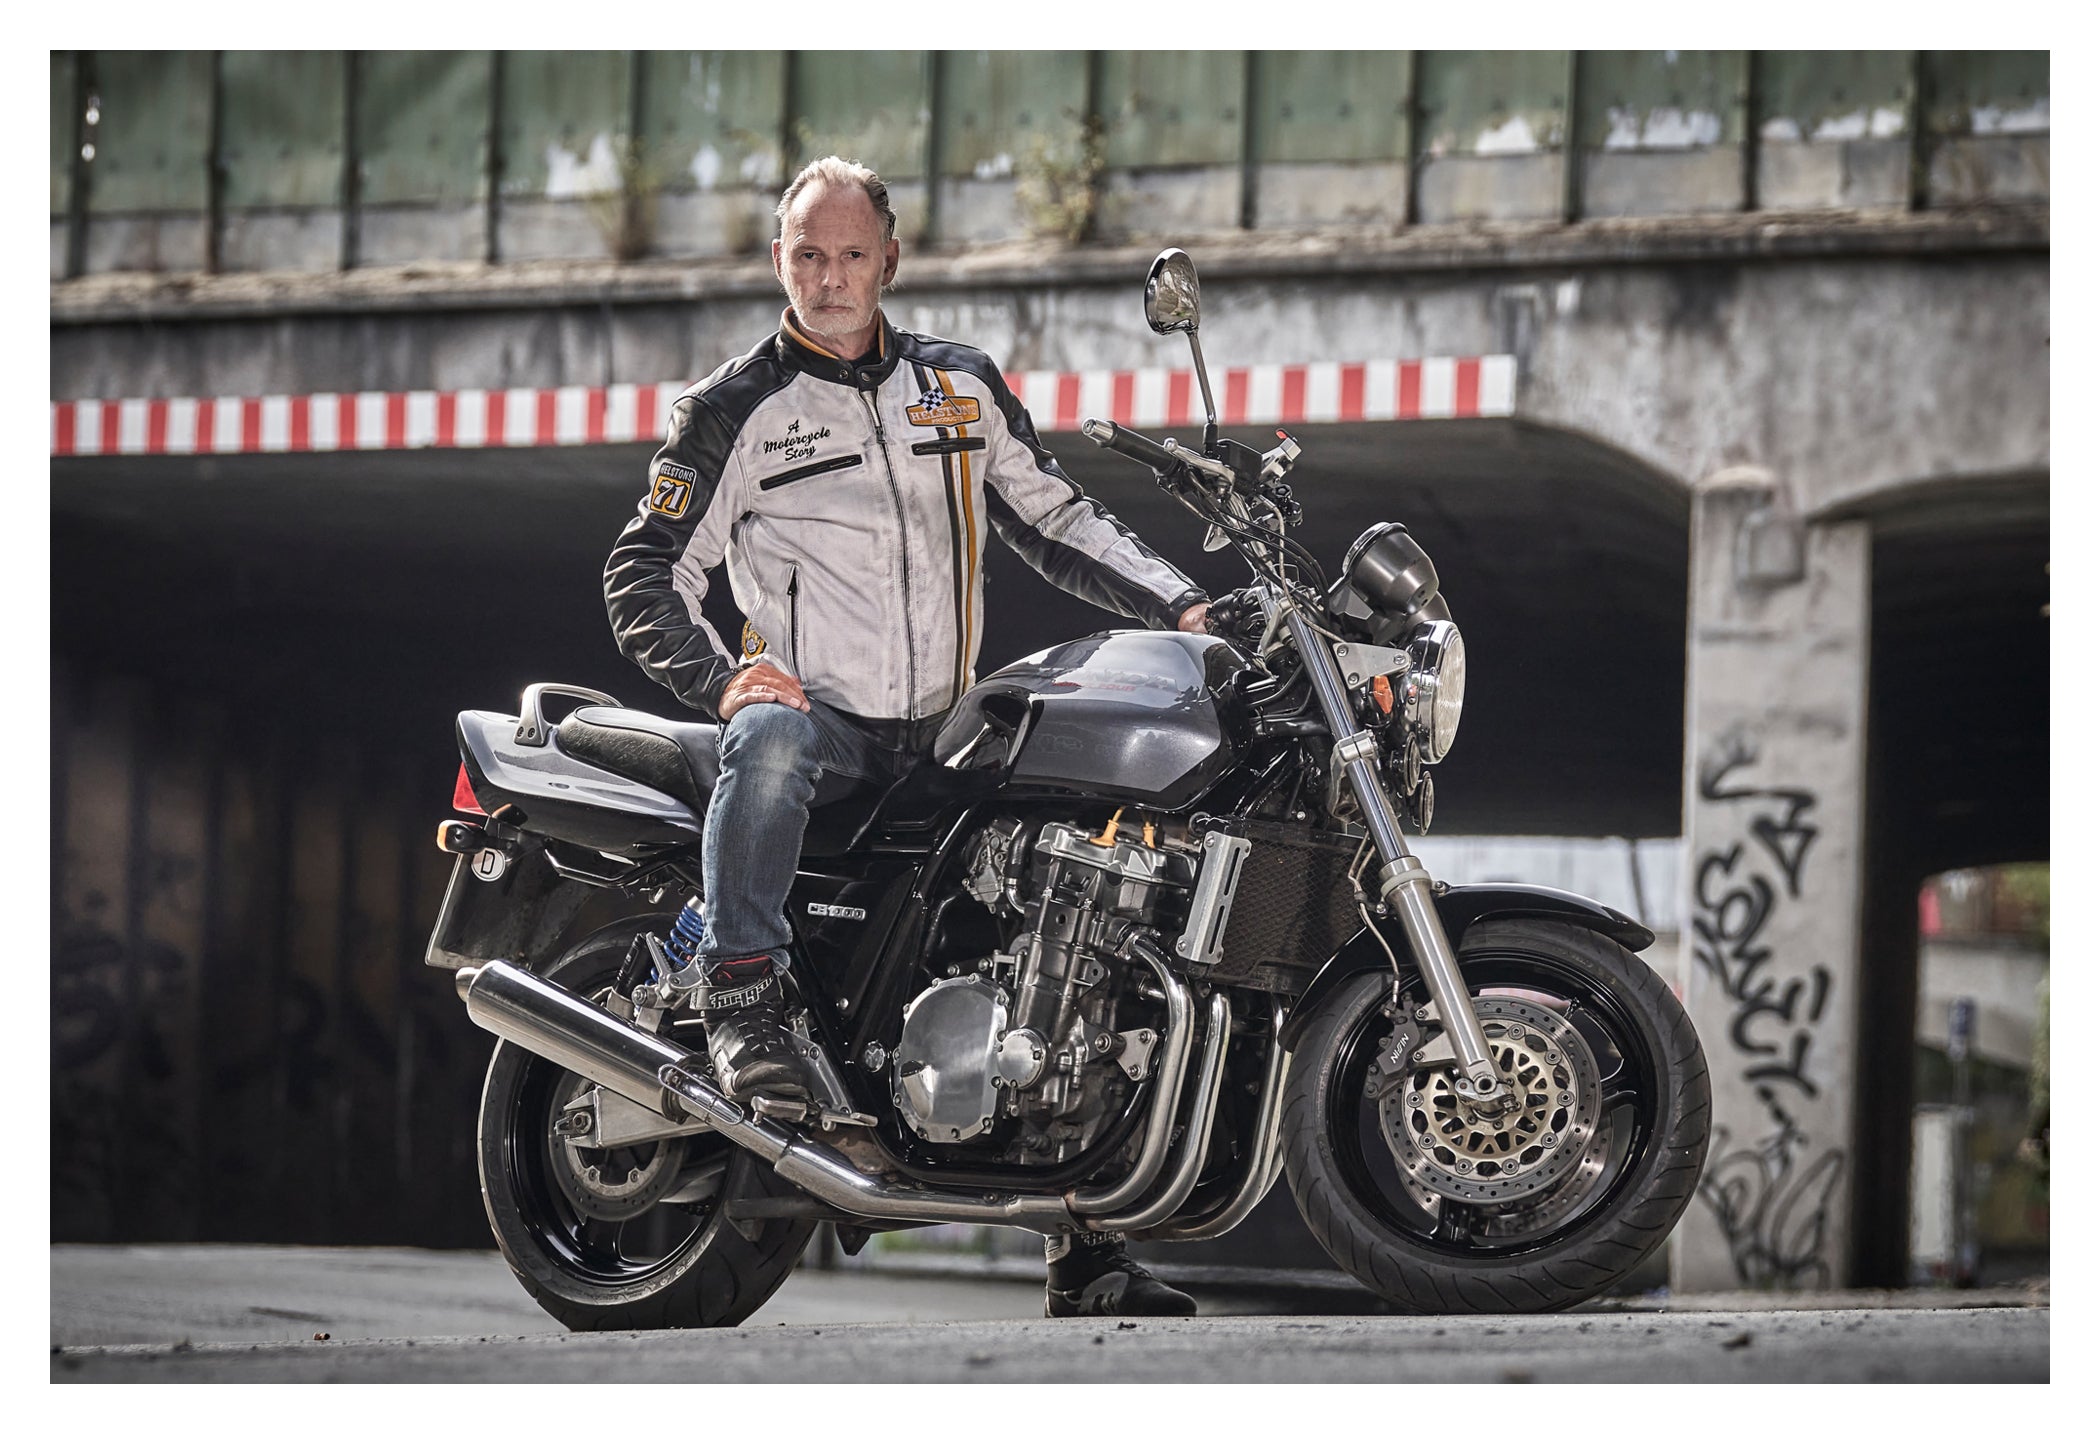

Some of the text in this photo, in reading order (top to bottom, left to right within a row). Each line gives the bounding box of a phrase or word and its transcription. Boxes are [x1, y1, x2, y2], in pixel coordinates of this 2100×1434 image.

[787, 418, 800, 435] A
[762, 426, 831, 454] Motorcycle
[784, 446, 816, 461] Story
[660, 464, 694, 482] HELSTONS
[653, 480, 689, 513] 71
[480, 850, 496, 875] D
[807, 902, 866, 921] CB1000
